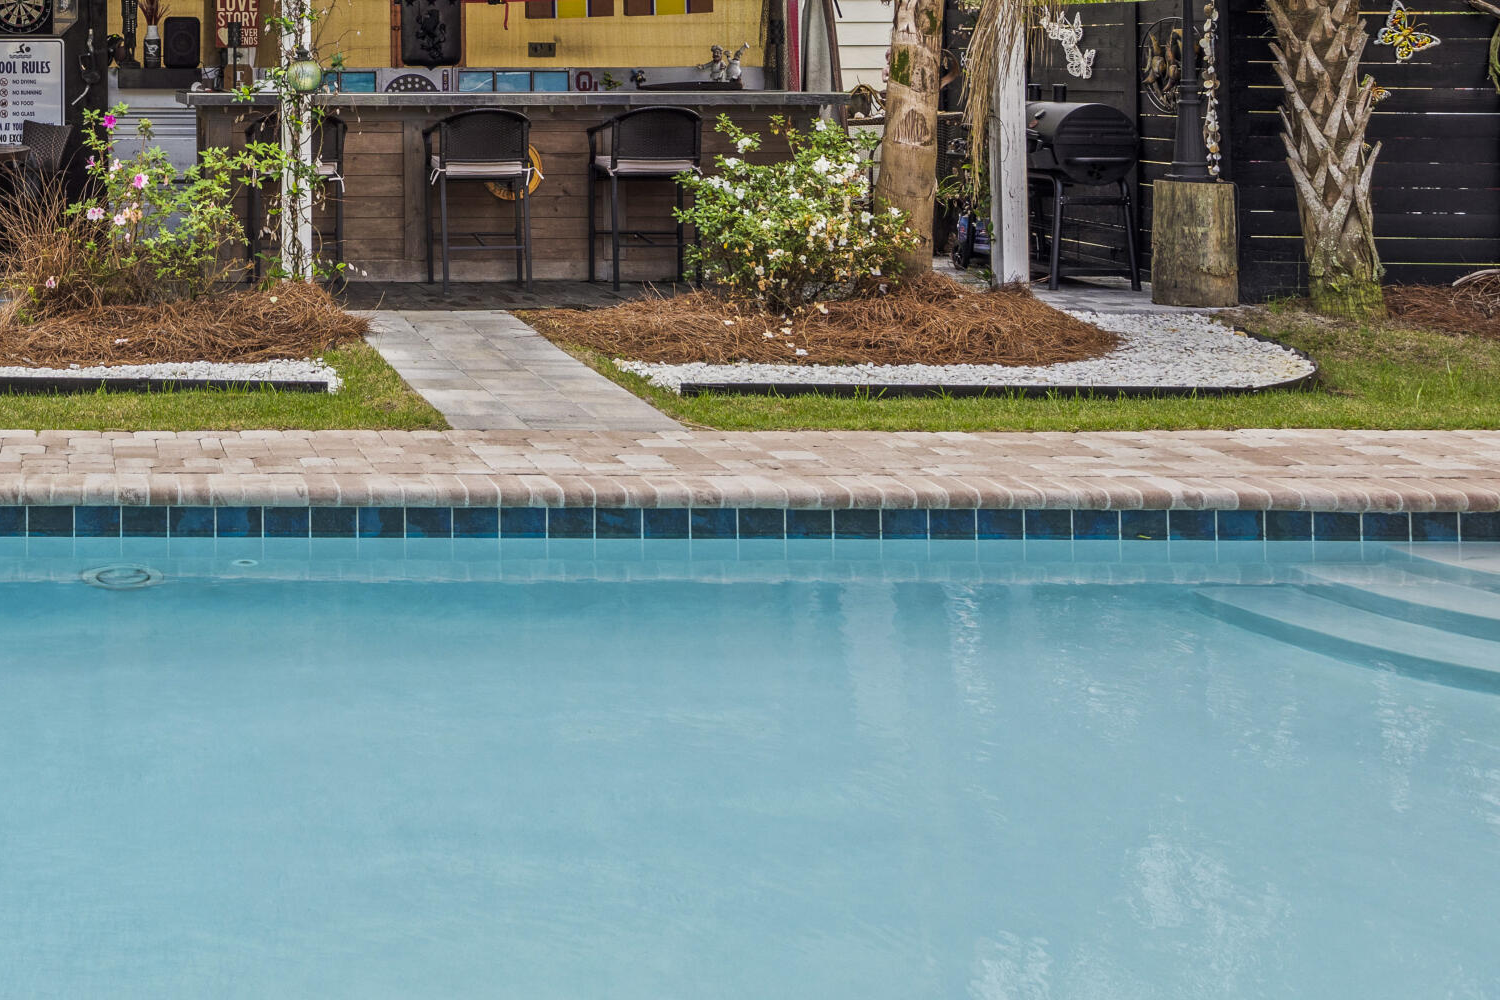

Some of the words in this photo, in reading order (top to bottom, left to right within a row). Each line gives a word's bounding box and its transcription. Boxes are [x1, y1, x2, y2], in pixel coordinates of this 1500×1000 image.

[217, 11, 258, 27] STORY
[240, 28, 258, 37] EVER
[21, 61, 51, 74] RULES
[4, 122, 10, 131] AT
[13, 122, 23, 131] YOU
